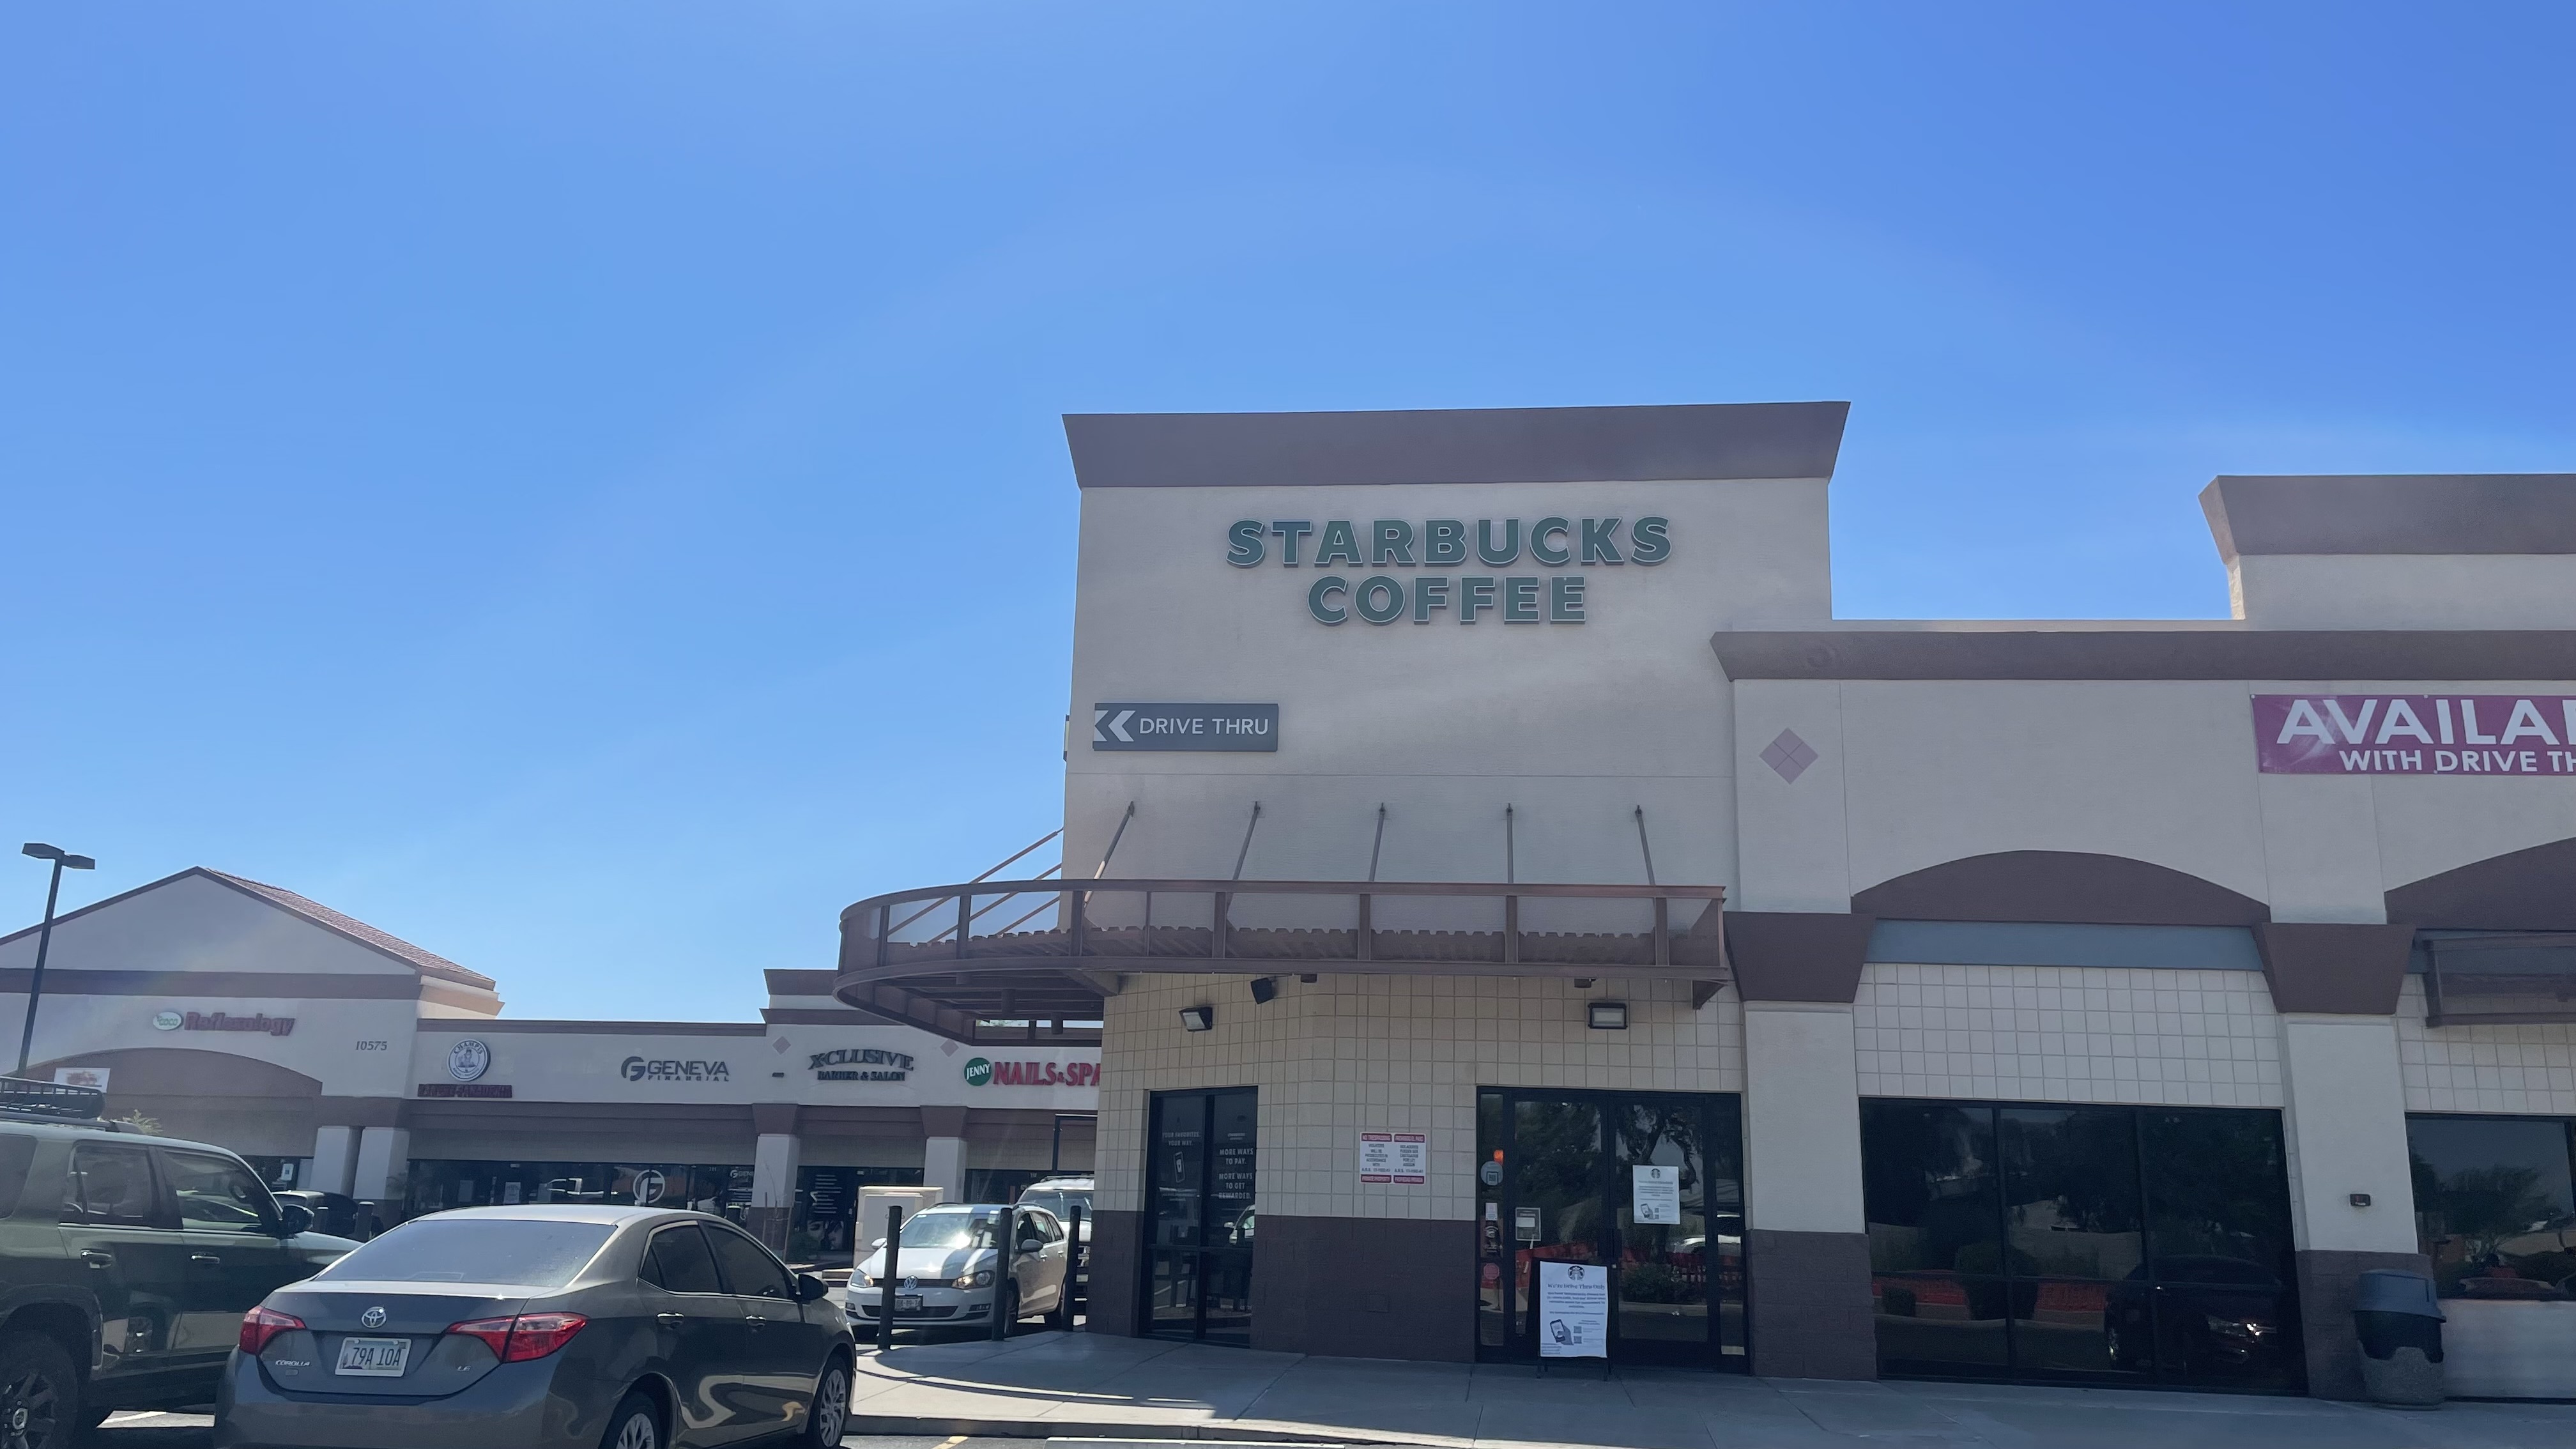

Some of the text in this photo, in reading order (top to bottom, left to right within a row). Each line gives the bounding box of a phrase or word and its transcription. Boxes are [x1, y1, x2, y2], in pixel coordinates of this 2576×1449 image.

[1226, 516, 1672, 567] STARBUCKS
[1307, 575, 1586, 625] COFFEE
[1139, 717, 1268, 735] DRIVE THRU
[2339, 749, 2422, 771] WITH
[2435, 750, 2538, 772] DRIVE
[184, 1011, 296, 1036] Reflexology
[356, 1041, 388, 1052] 10575
[647, 1060, 730, 1075] GENEVA
[808, 1049, 914, 1071] XCLUSIVE
[860, 1071, 869, 1081] &
[870, 1071, 906, 1081] SALON
[965, 1063, 990, 1080] JENNY
